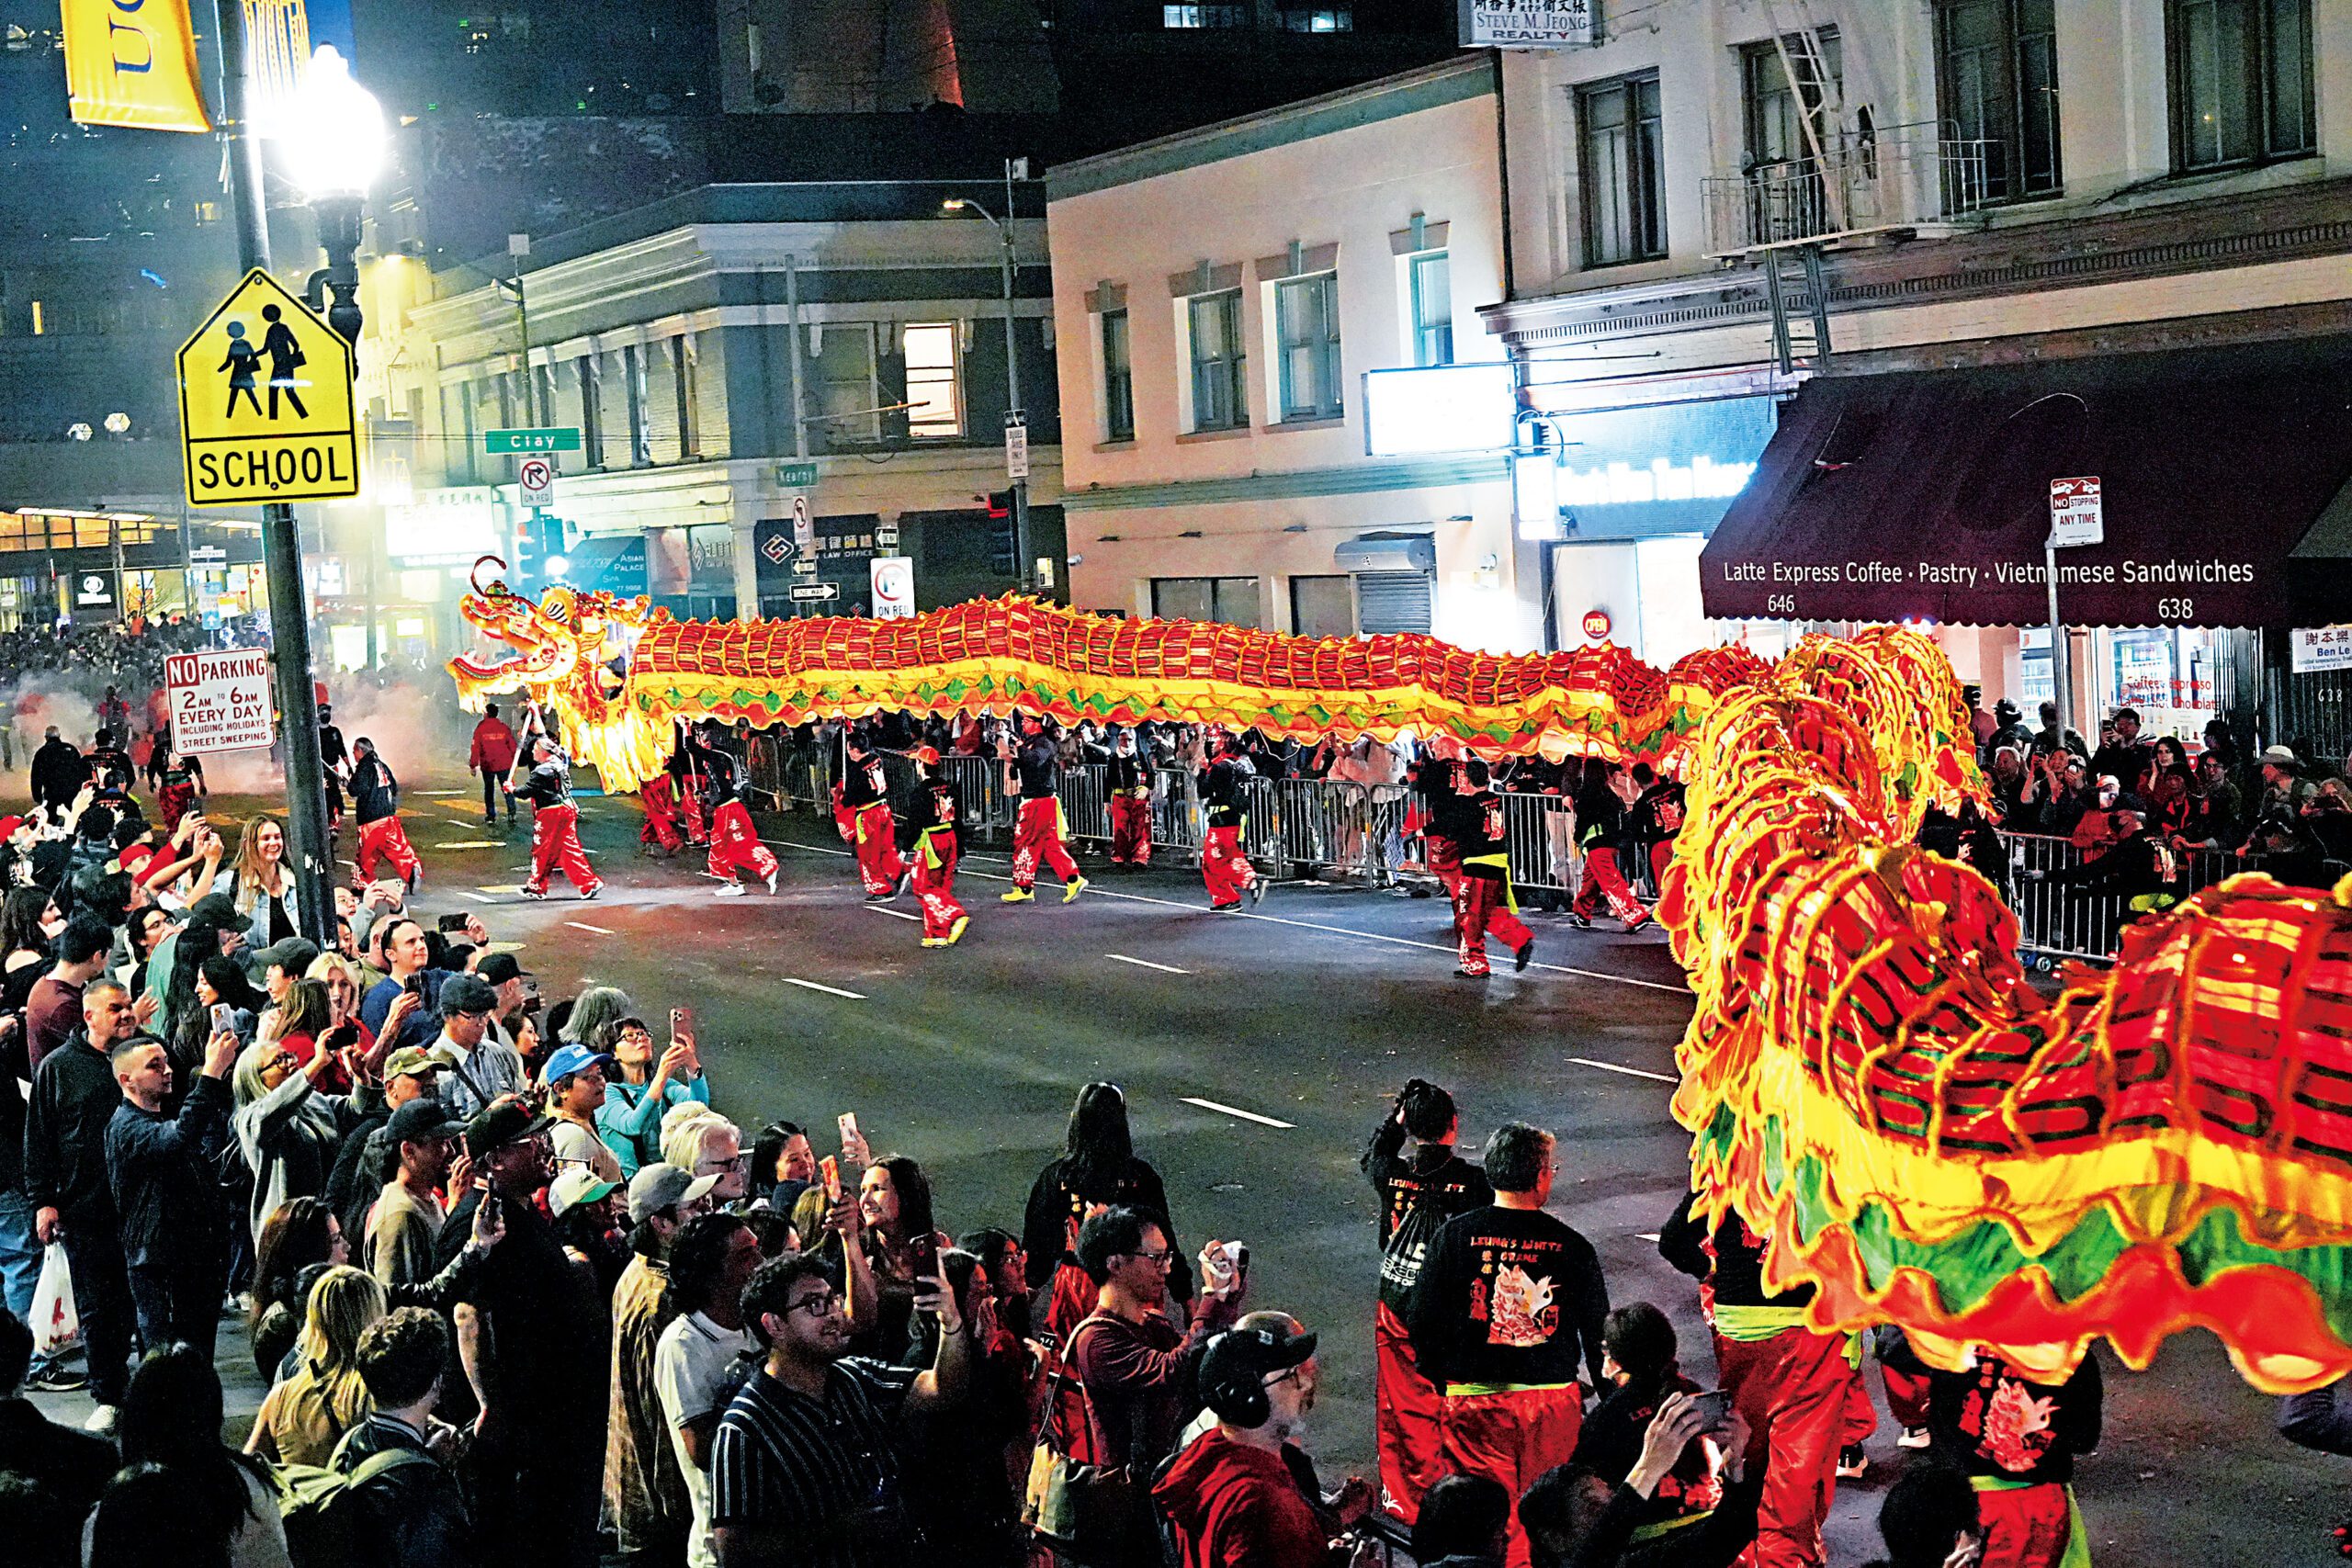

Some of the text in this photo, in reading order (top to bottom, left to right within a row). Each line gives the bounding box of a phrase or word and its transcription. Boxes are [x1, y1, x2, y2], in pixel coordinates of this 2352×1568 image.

[1476, 12, 1520, 28] STEVE
[1544, 14, 1587, 30] JEONG
[1492, 30, 1569, 39] REALTY
[511, 435, 555, 449] Clay
[198, 446, 348, 489] SCHOOL
[2054, 497, 2098, 508] NO STOPPING
[2060, 513, 2096, 525] ANY TIME
[1724, 562, 1766, 581] Latte
[1773, 561, 1838, 585] Express
[1846, 561, 1903, 582] Coffee
[1919, 562, 1978, 588] Pastry
[2122, 558, 2254, 583] Sandwiches
[878, 605, 910, 616] ON RED
[1768, 594, 1795, 613] 646
[2159, 598, 2194, 619] 638
[1585, 616, 1607, 633] OPEN
[2317, 648, 2335, 657] Ben
[169, 658, 266, 684] NO PARKING
[2318, 688, 2343, 703] 638
[178, 704, 264, 725] EVERY DAY
[180, 719, 266, 735] INCLUDING HOLIDAYS
[182, 732, 266, 749] STREET SWEEPING
